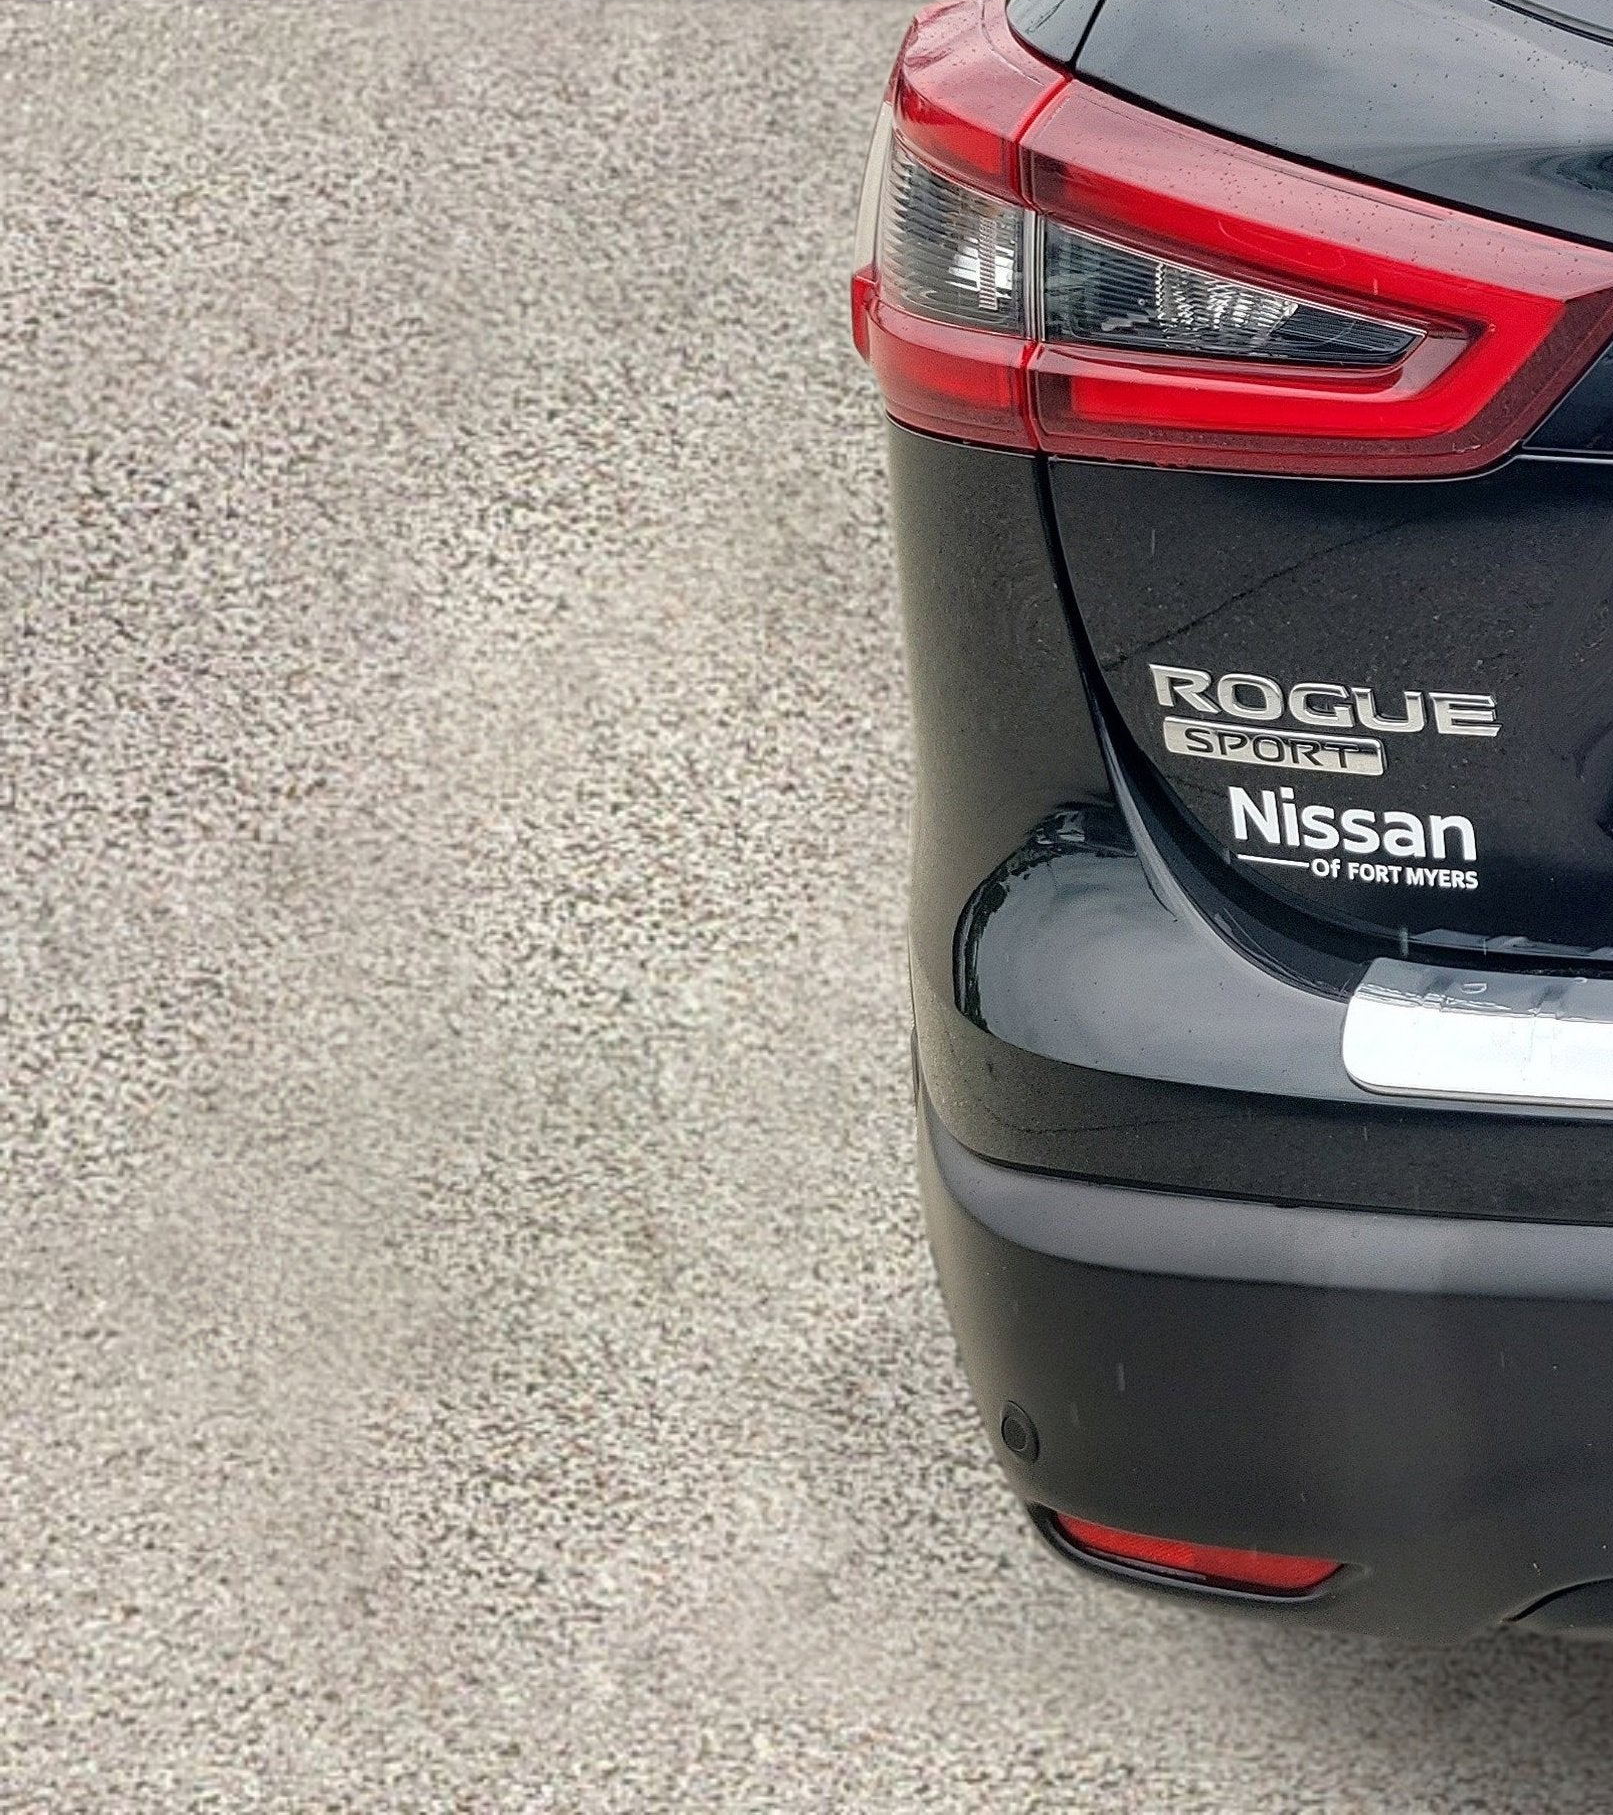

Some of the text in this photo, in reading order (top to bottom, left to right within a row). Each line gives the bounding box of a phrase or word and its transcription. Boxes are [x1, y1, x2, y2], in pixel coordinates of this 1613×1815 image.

[1149, 663, 1502, 738] ROGUE
[1186, 727, 1359, 769] SPORT
[1229, 786, 1477, 861] Nissan
[1348, 862, 1402, 884] FORT
[1406, 867, 1479, 889] MYERS
